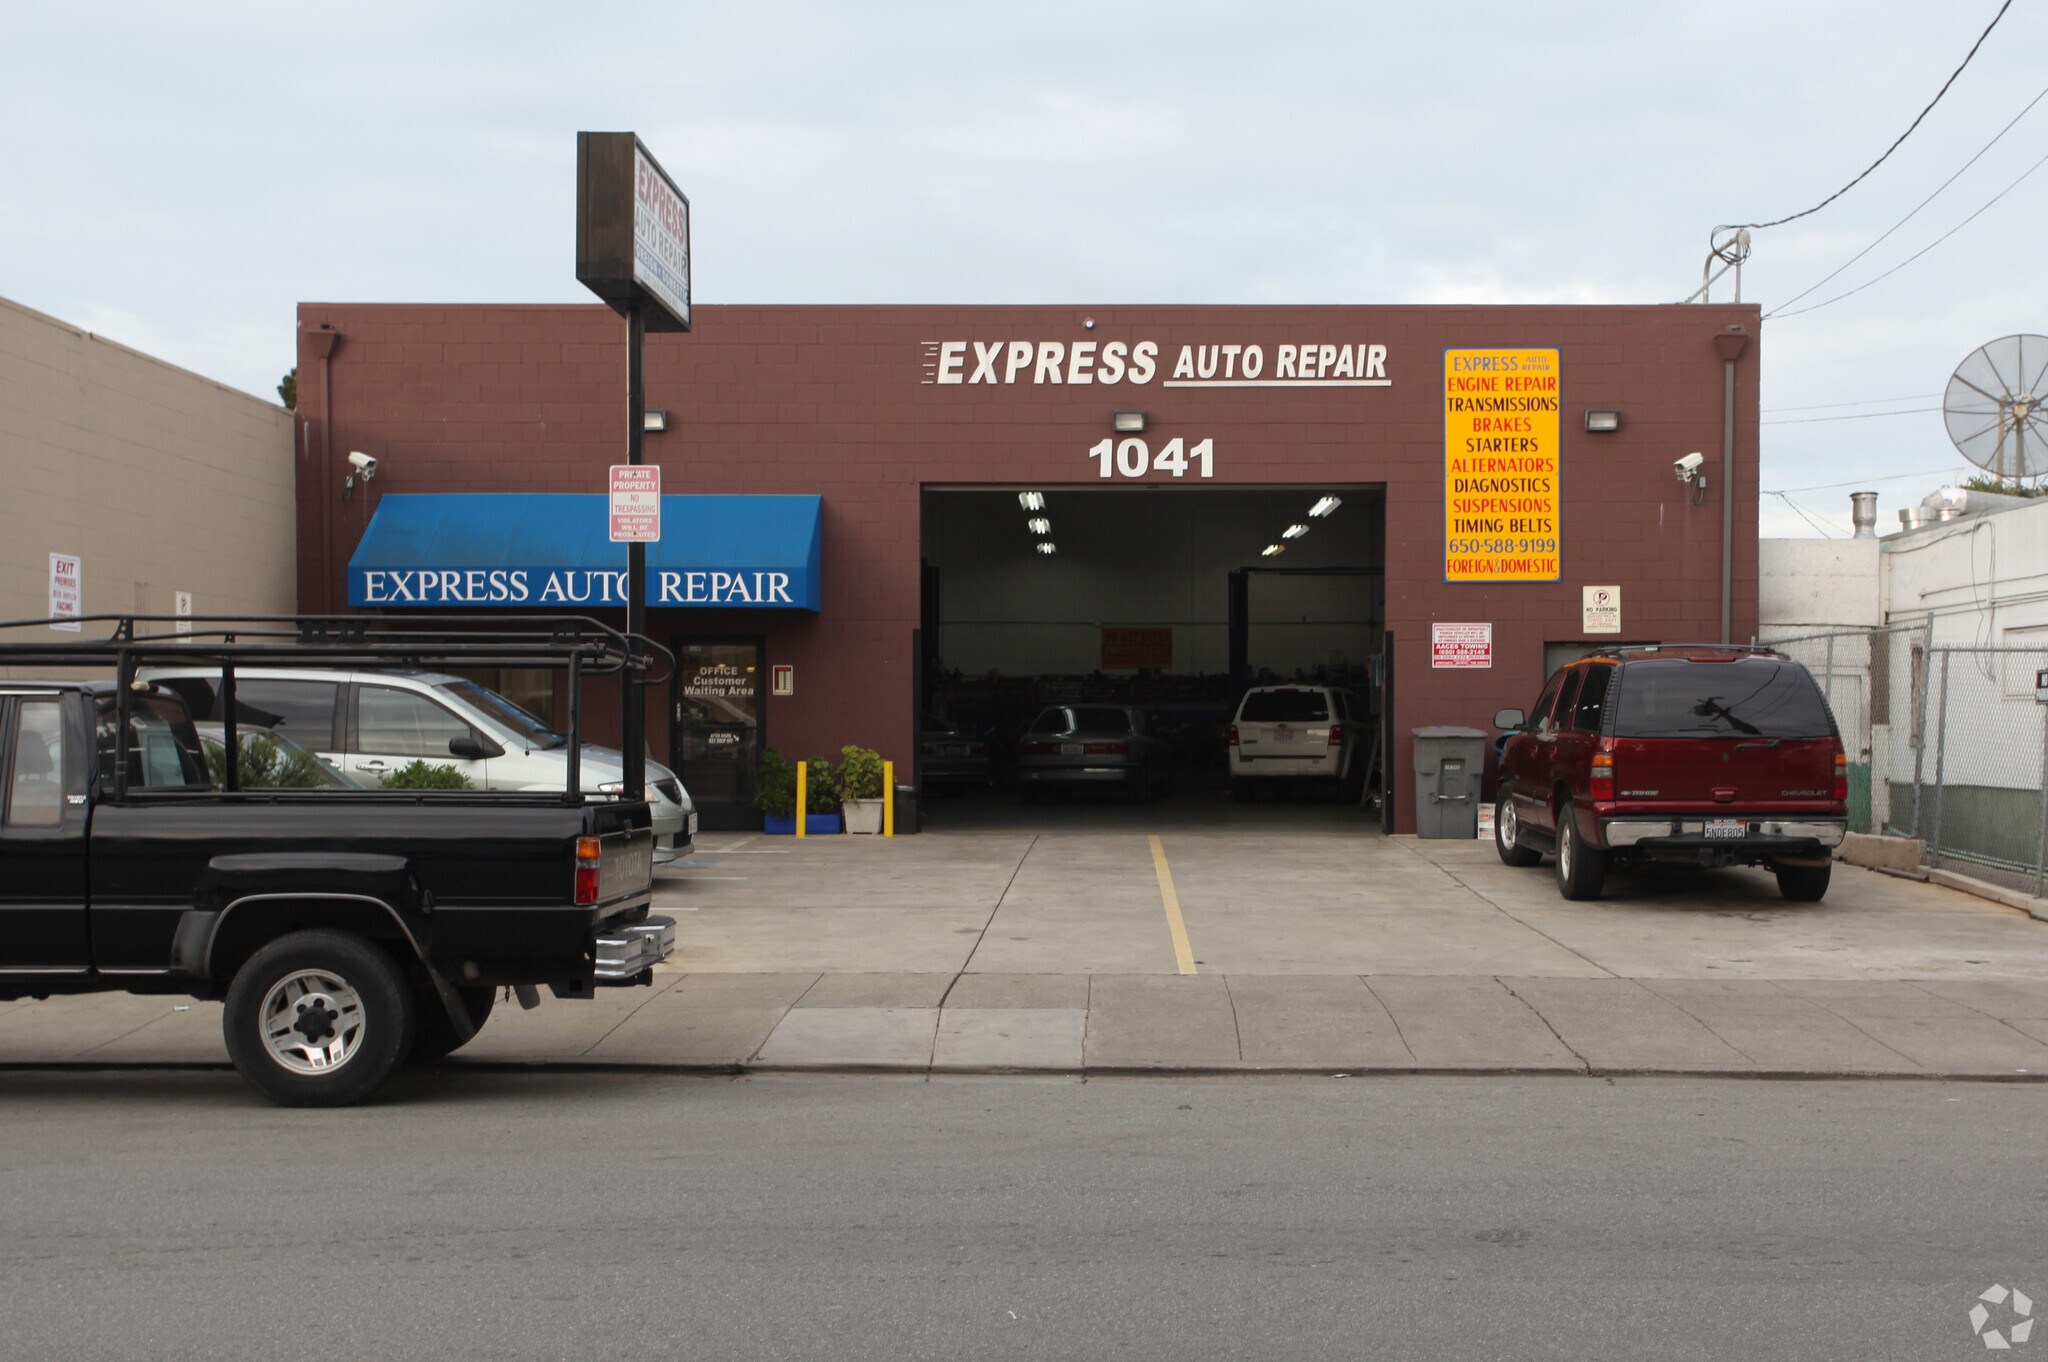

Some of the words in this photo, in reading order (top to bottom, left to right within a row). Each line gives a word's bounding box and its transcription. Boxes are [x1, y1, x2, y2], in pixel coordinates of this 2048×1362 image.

[637, 157, 686, 246] EXPRESS
[635, 206, 657, 250] AUTO
[658, 236, 688, 279] REPAIR
[635, 241, 659, 277] OREIGN
[937, 341, 1159, 384] EXPRESS
[1173, 345, 1264, 379] AUTO
[1276, 344, 1388, 379] REPAIR
[1454, 356, 1518, 372] EXPRESS
[1447, 377, 1499, 392] ENGINE
[1505, 377, 1556, 392] REPAIR
[1447, 397, 1558, 412] TRANSMISSIONS
[1473, 417, 1532, 432] BRAKES
[1466, 437, 1538, 452] STARTERS
[1089, 438, 1214, 478] 1041
[1451, 457, 1554, 473] ALTERNATORS
[618, 470, 652, 479] PRIVATE
[613, 481, 657, 490] PROPERTY
[1454, 478, 1551, 493] DIAGNOSTICS
[630, 494, 640, 503] NO
[1453, 498, 1552, 513] SUSPENSIONS
[614, 505, 656, 514] TRESPASSING
[1453, 518, 1504, 533] TIMING
[1509, 518, 1552, 533] BELTS
[56, 561, 75, 575] EXIT
[363, 570, 530, 602] EXPRESS
[658, 571, 794, 603] REPAIR
[56, 601, 73, 612] FACING
[700, 667, 738, 675] OFFICE
[693, 676, 747, 686] Customer
[684, 686, 726, 697] Waiting
[728, 686, 755, 696] Area
[614, 851, 642, 882] TOYOTA
